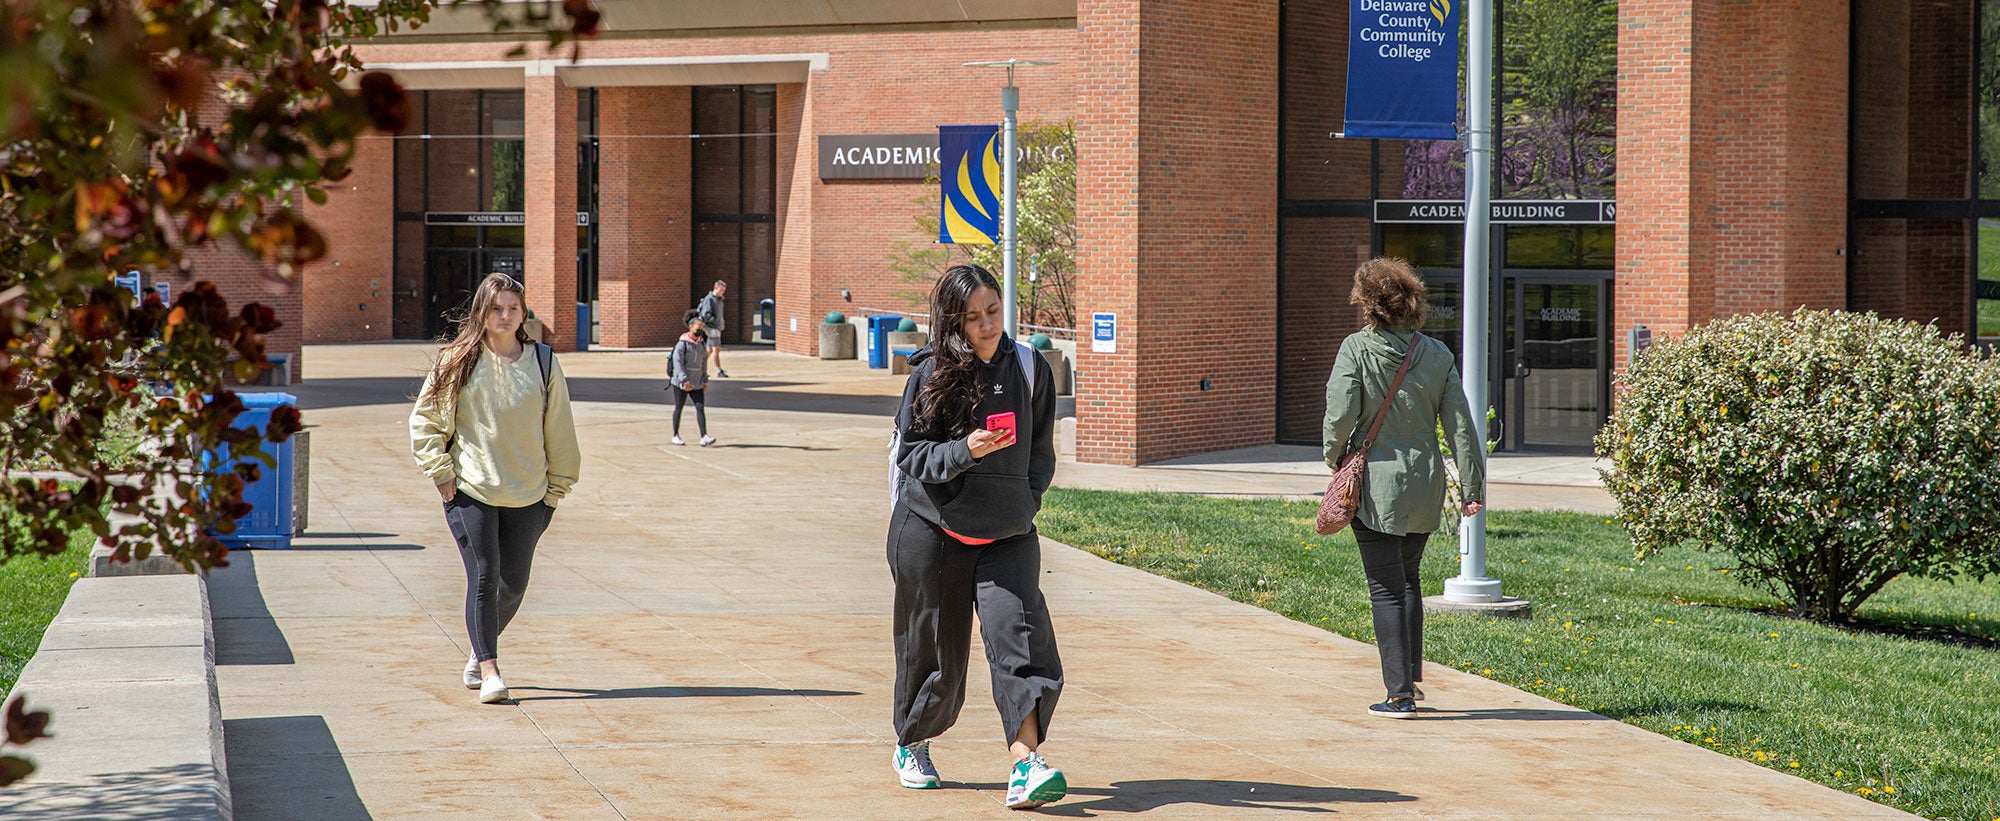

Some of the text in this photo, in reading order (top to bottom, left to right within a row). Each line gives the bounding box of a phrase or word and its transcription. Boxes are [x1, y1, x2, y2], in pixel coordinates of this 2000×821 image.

[1360, 0, 1426, 12] Delaware
[1378, 14, 1431, 31] County
[1360, 28, 1446, 46] Community
[1378, 44, 1431, 62] College
[1492, 206, 1565, 217] BUILDING
[1540, 307, 1582, 315] ACADEMIC
